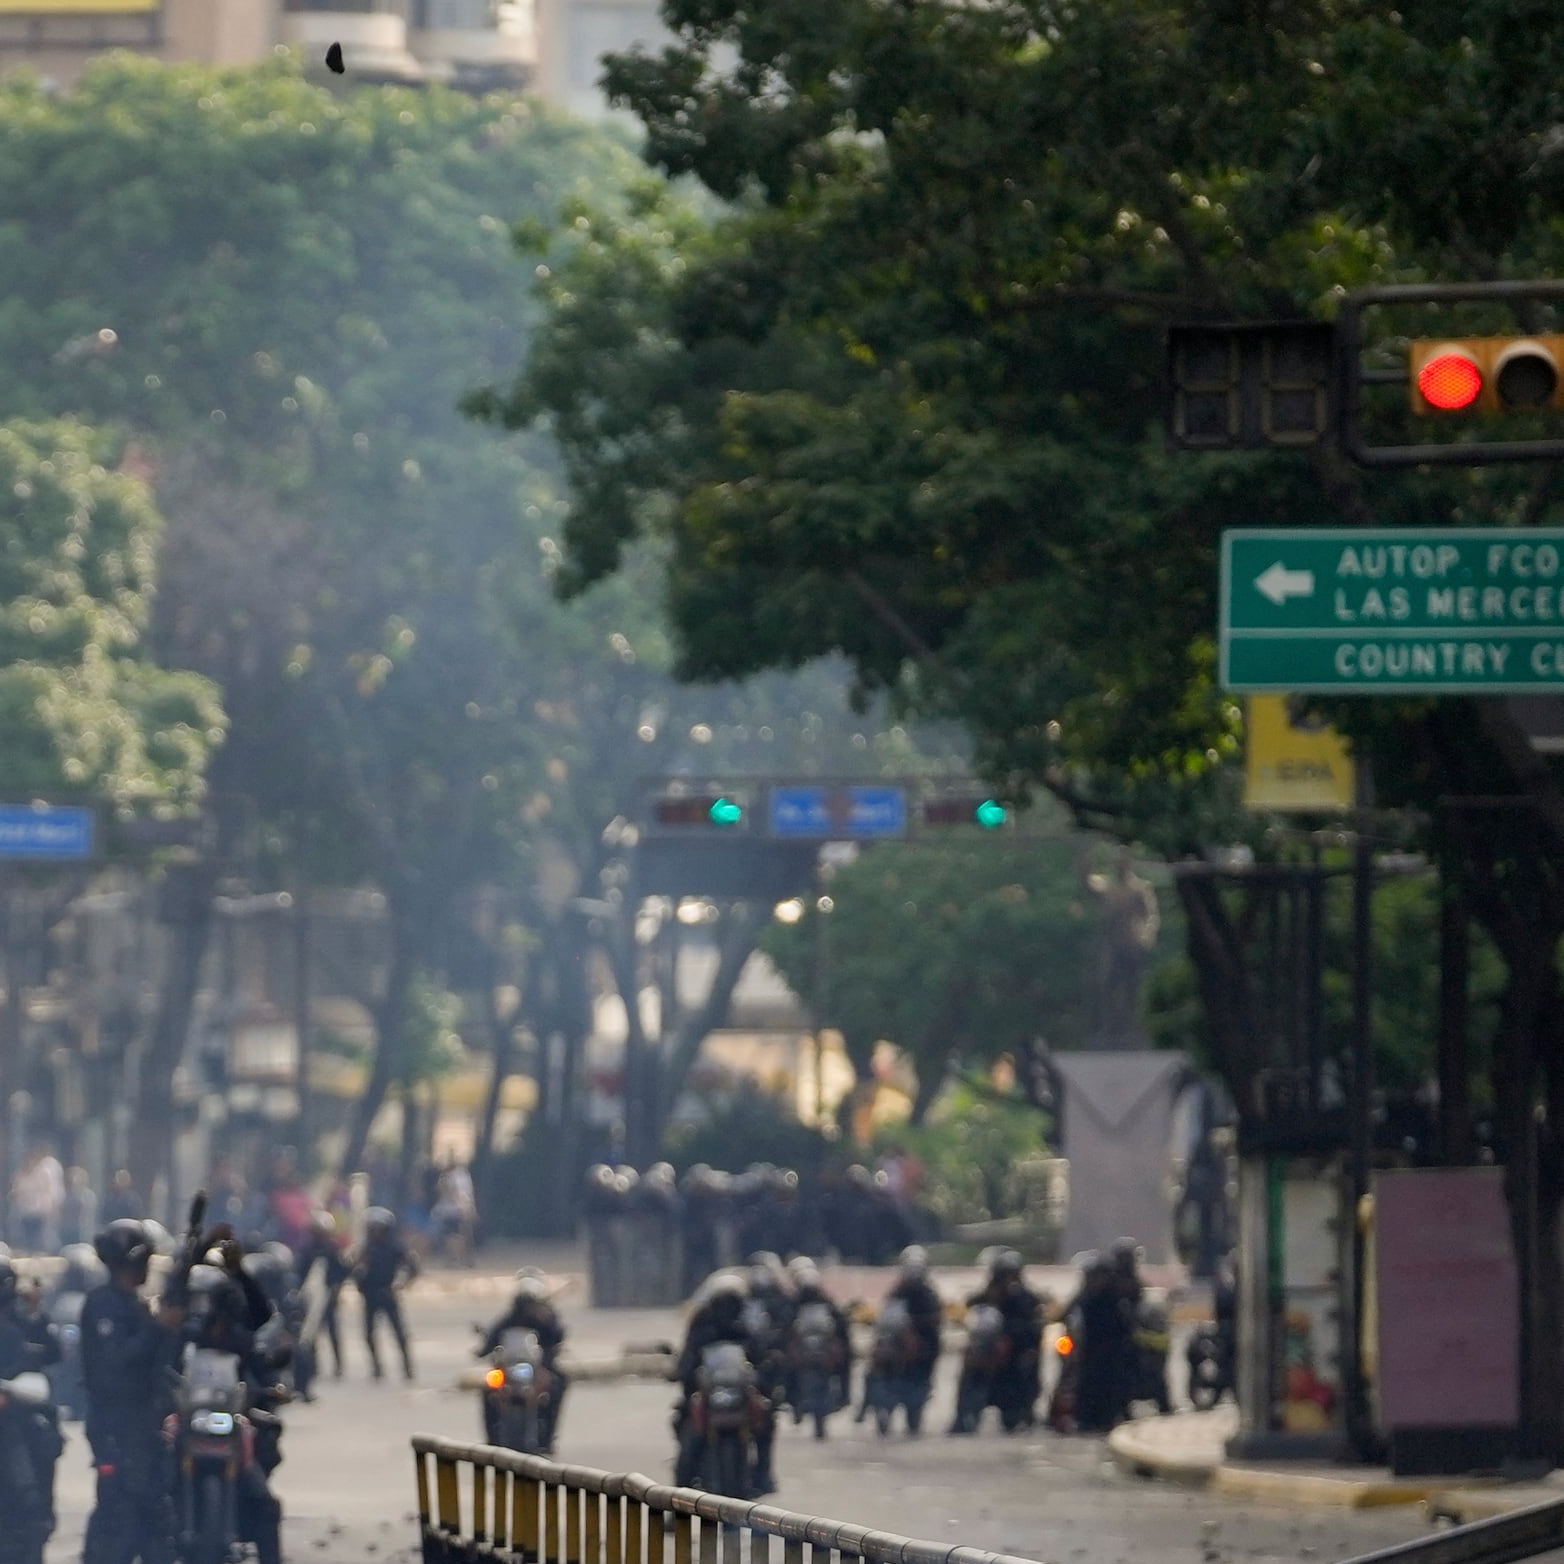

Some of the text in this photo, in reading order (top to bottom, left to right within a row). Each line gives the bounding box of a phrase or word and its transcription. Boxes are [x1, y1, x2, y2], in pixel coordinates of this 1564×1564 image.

[1334, 586, 1564, 621] LAS MERCE
[1334, 642, 1510, 677] COUNTRY
